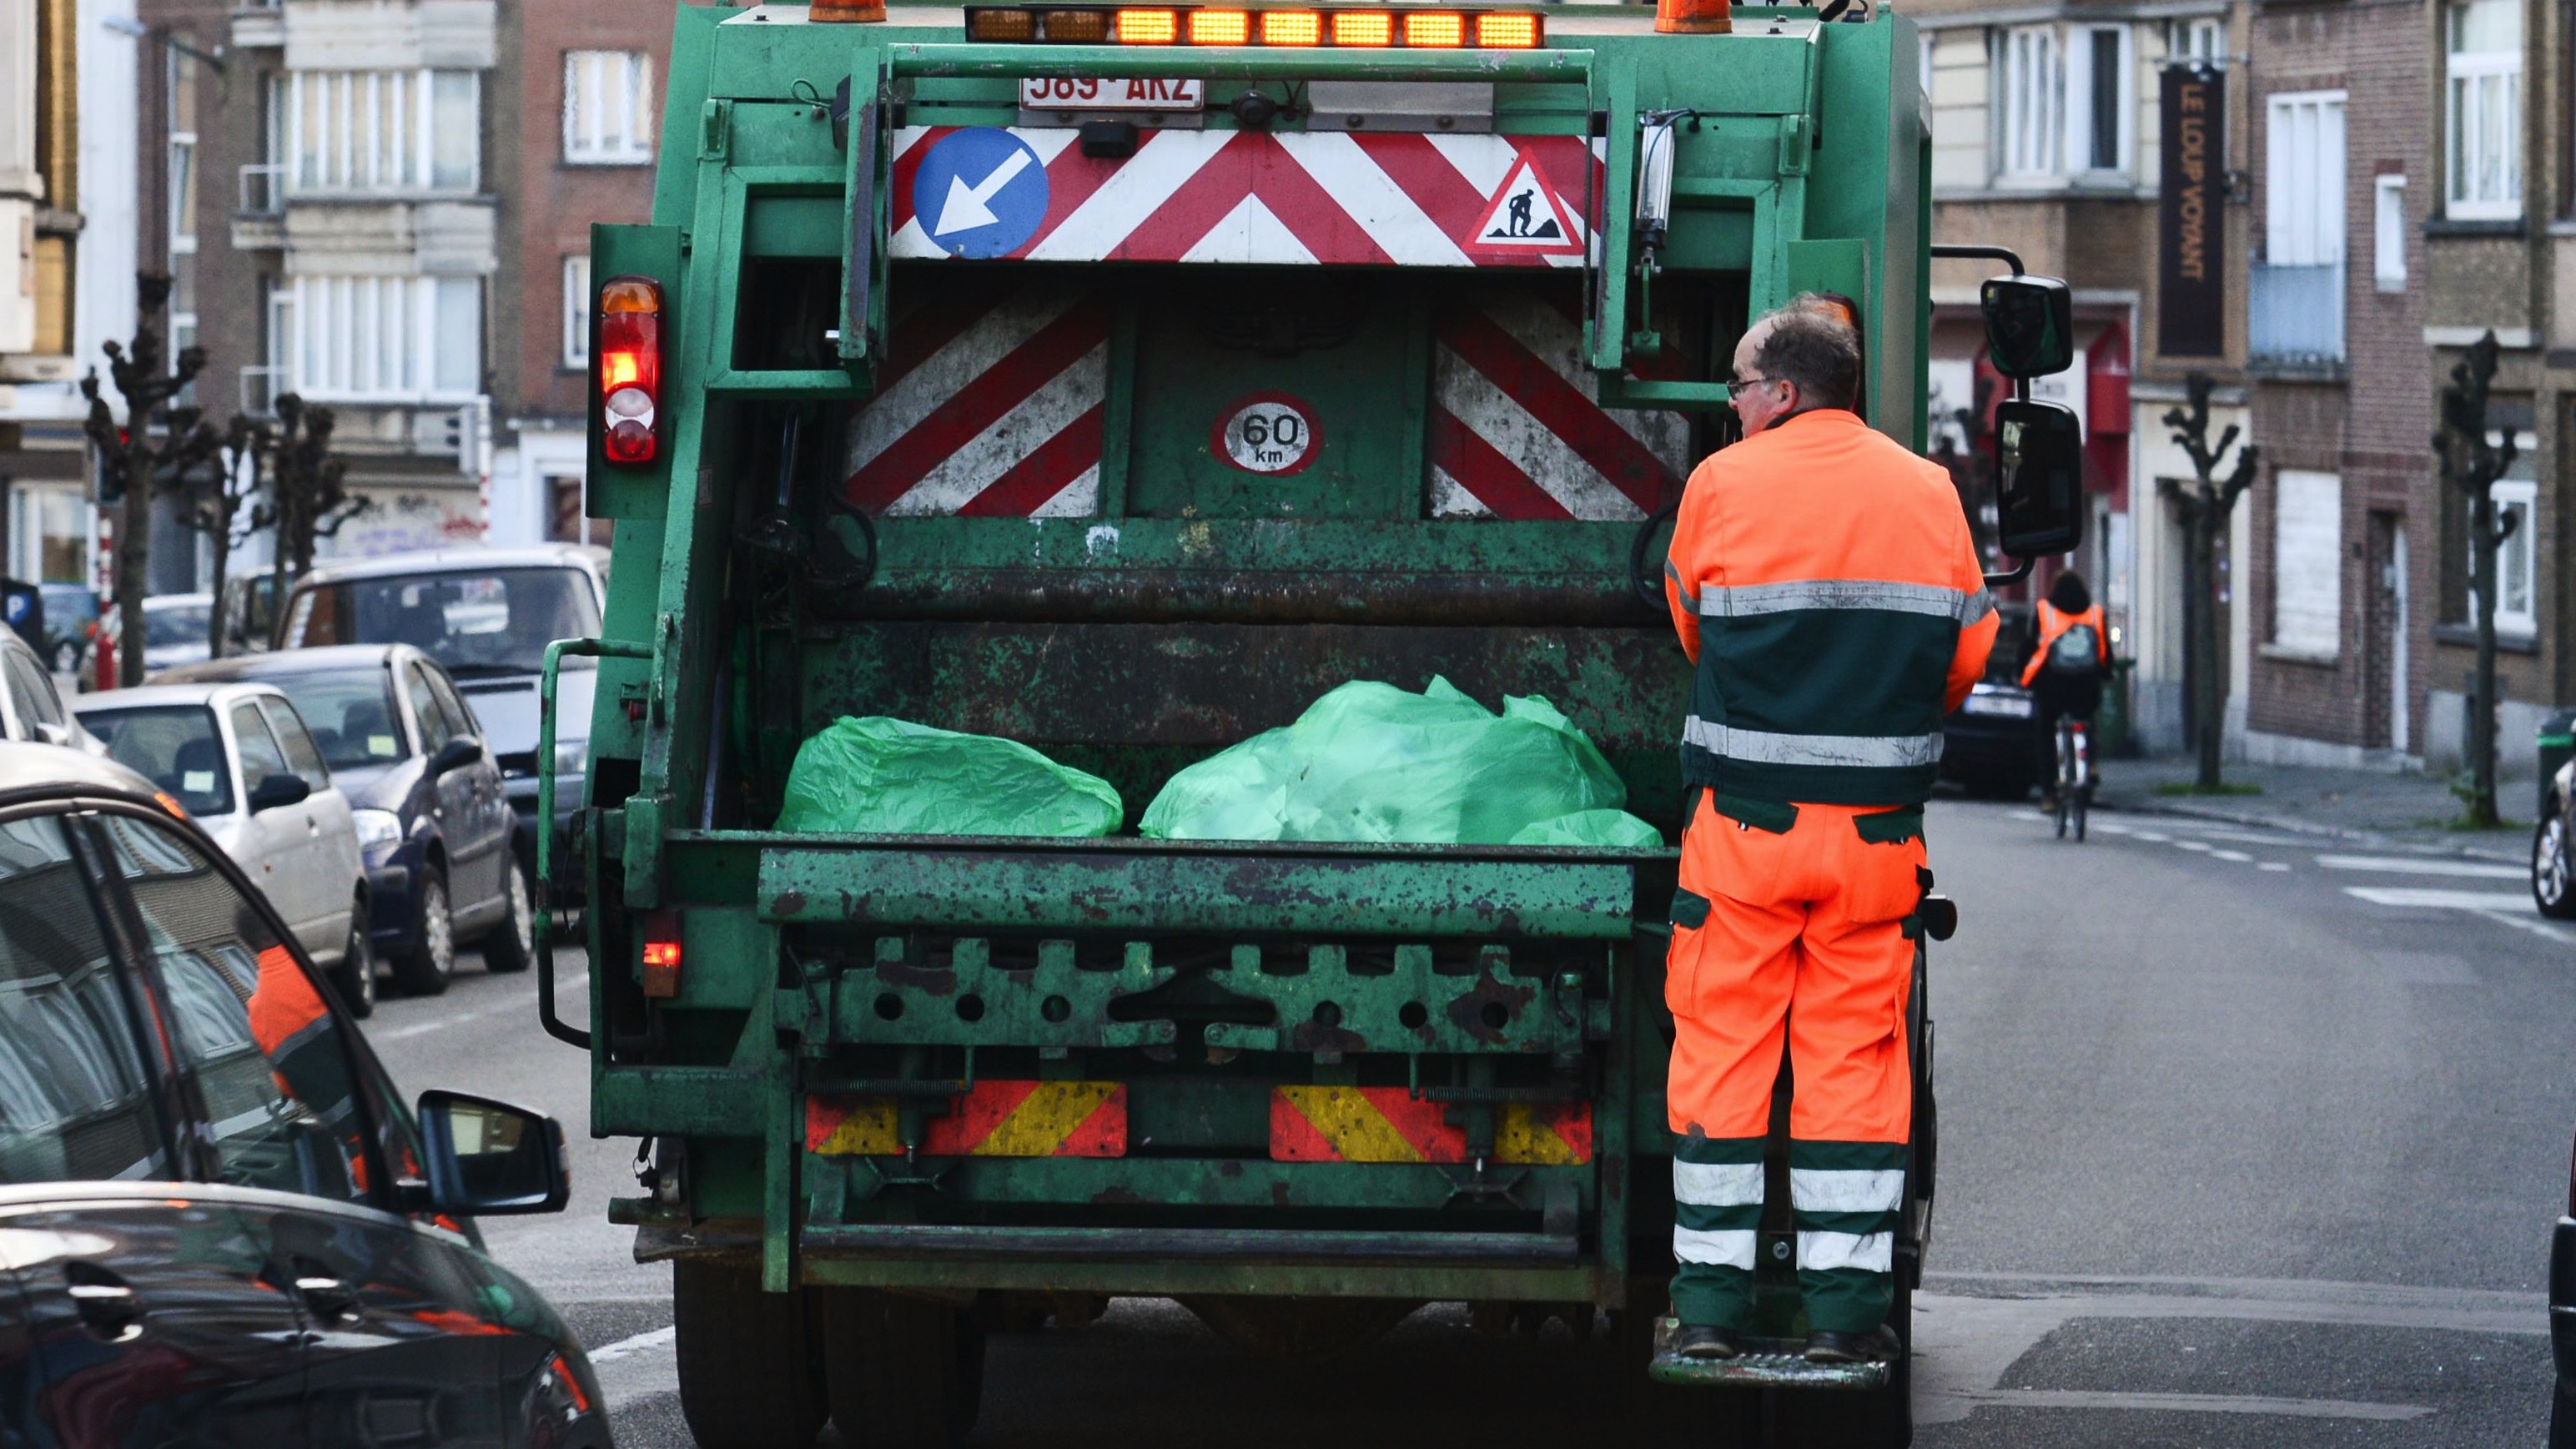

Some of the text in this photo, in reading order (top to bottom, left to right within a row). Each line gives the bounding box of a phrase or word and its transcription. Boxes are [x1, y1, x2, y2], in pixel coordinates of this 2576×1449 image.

[2181, 83, 2206, 280] LE LOUP VOYANT
[1243, 414, 1299, 445] 60
[1255, 448, 1283, 463] km
